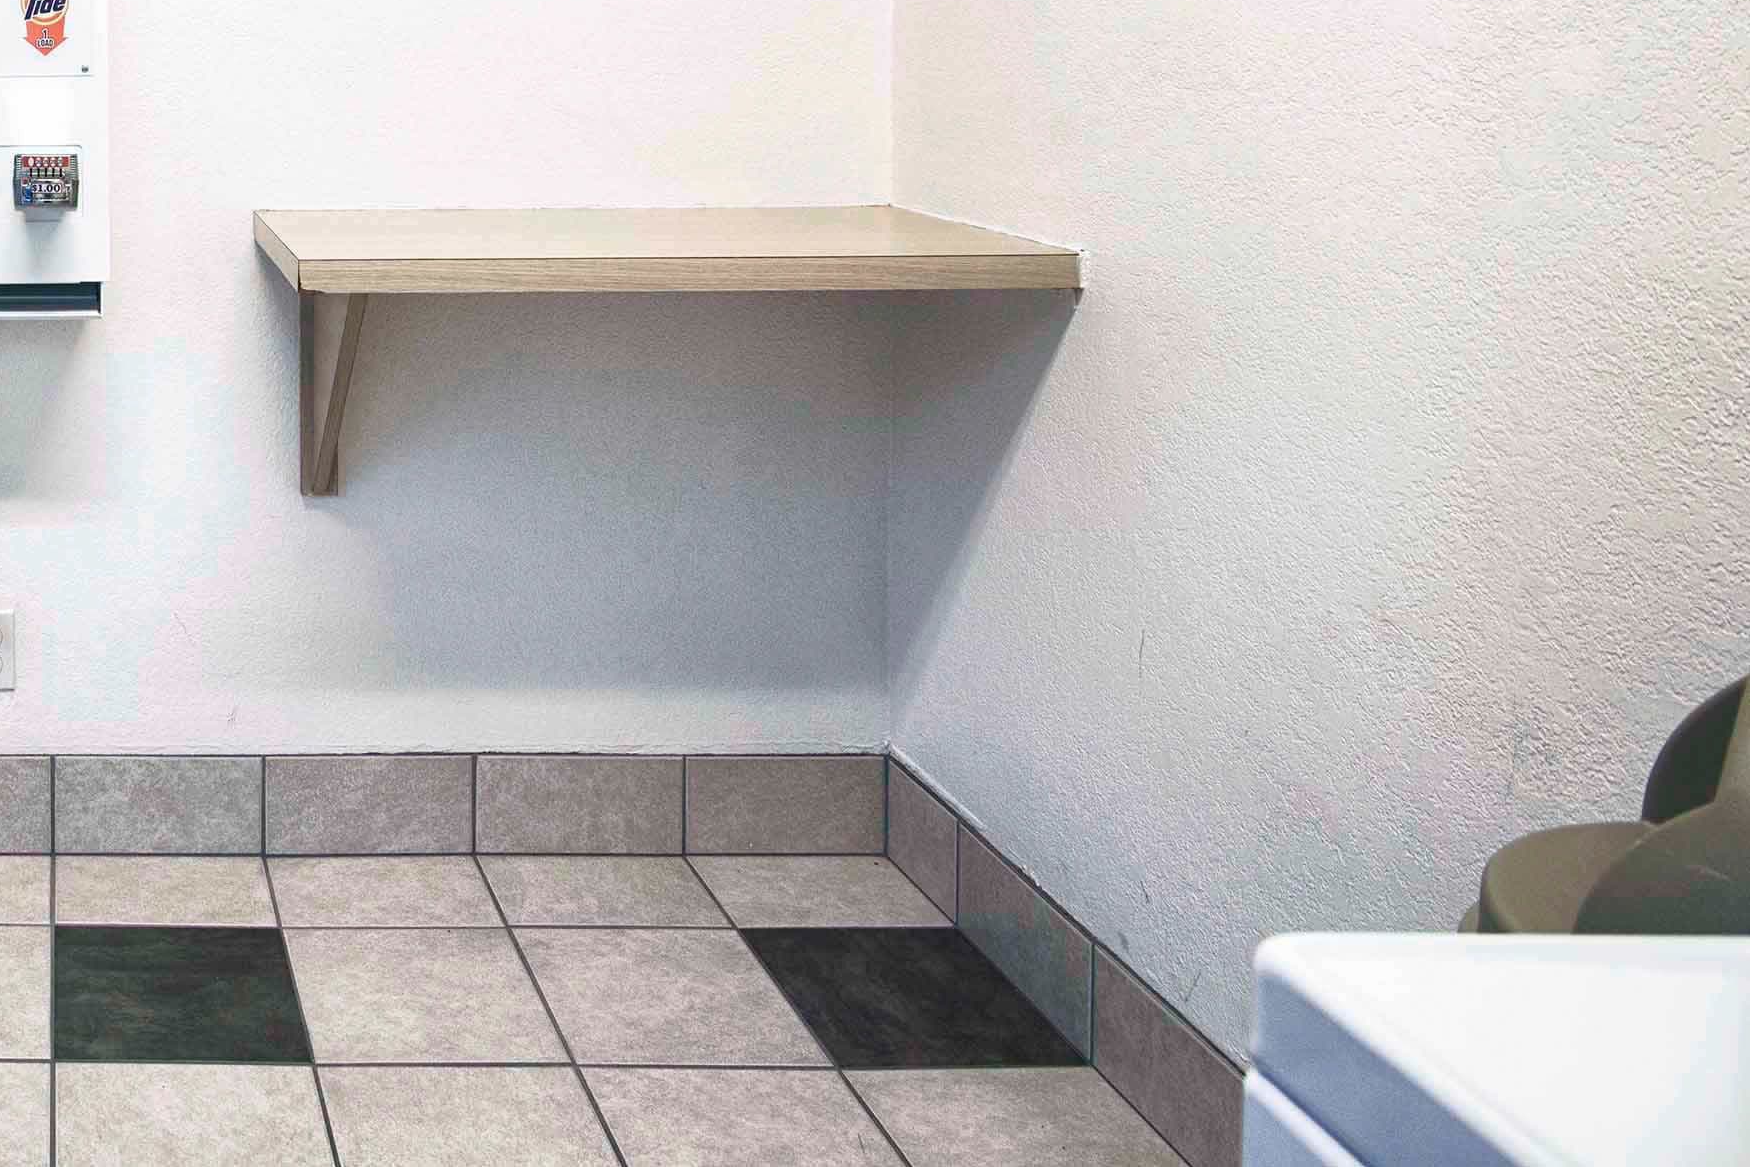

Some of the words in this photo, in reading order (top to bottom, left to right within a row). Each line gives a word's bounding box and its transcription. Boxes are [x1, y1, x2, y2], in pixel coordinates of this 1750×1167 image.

[42, 29, 49, 40] 1
[37, 39, 54, 47] LOAD
[32, 184, 61, 193] $1.00
